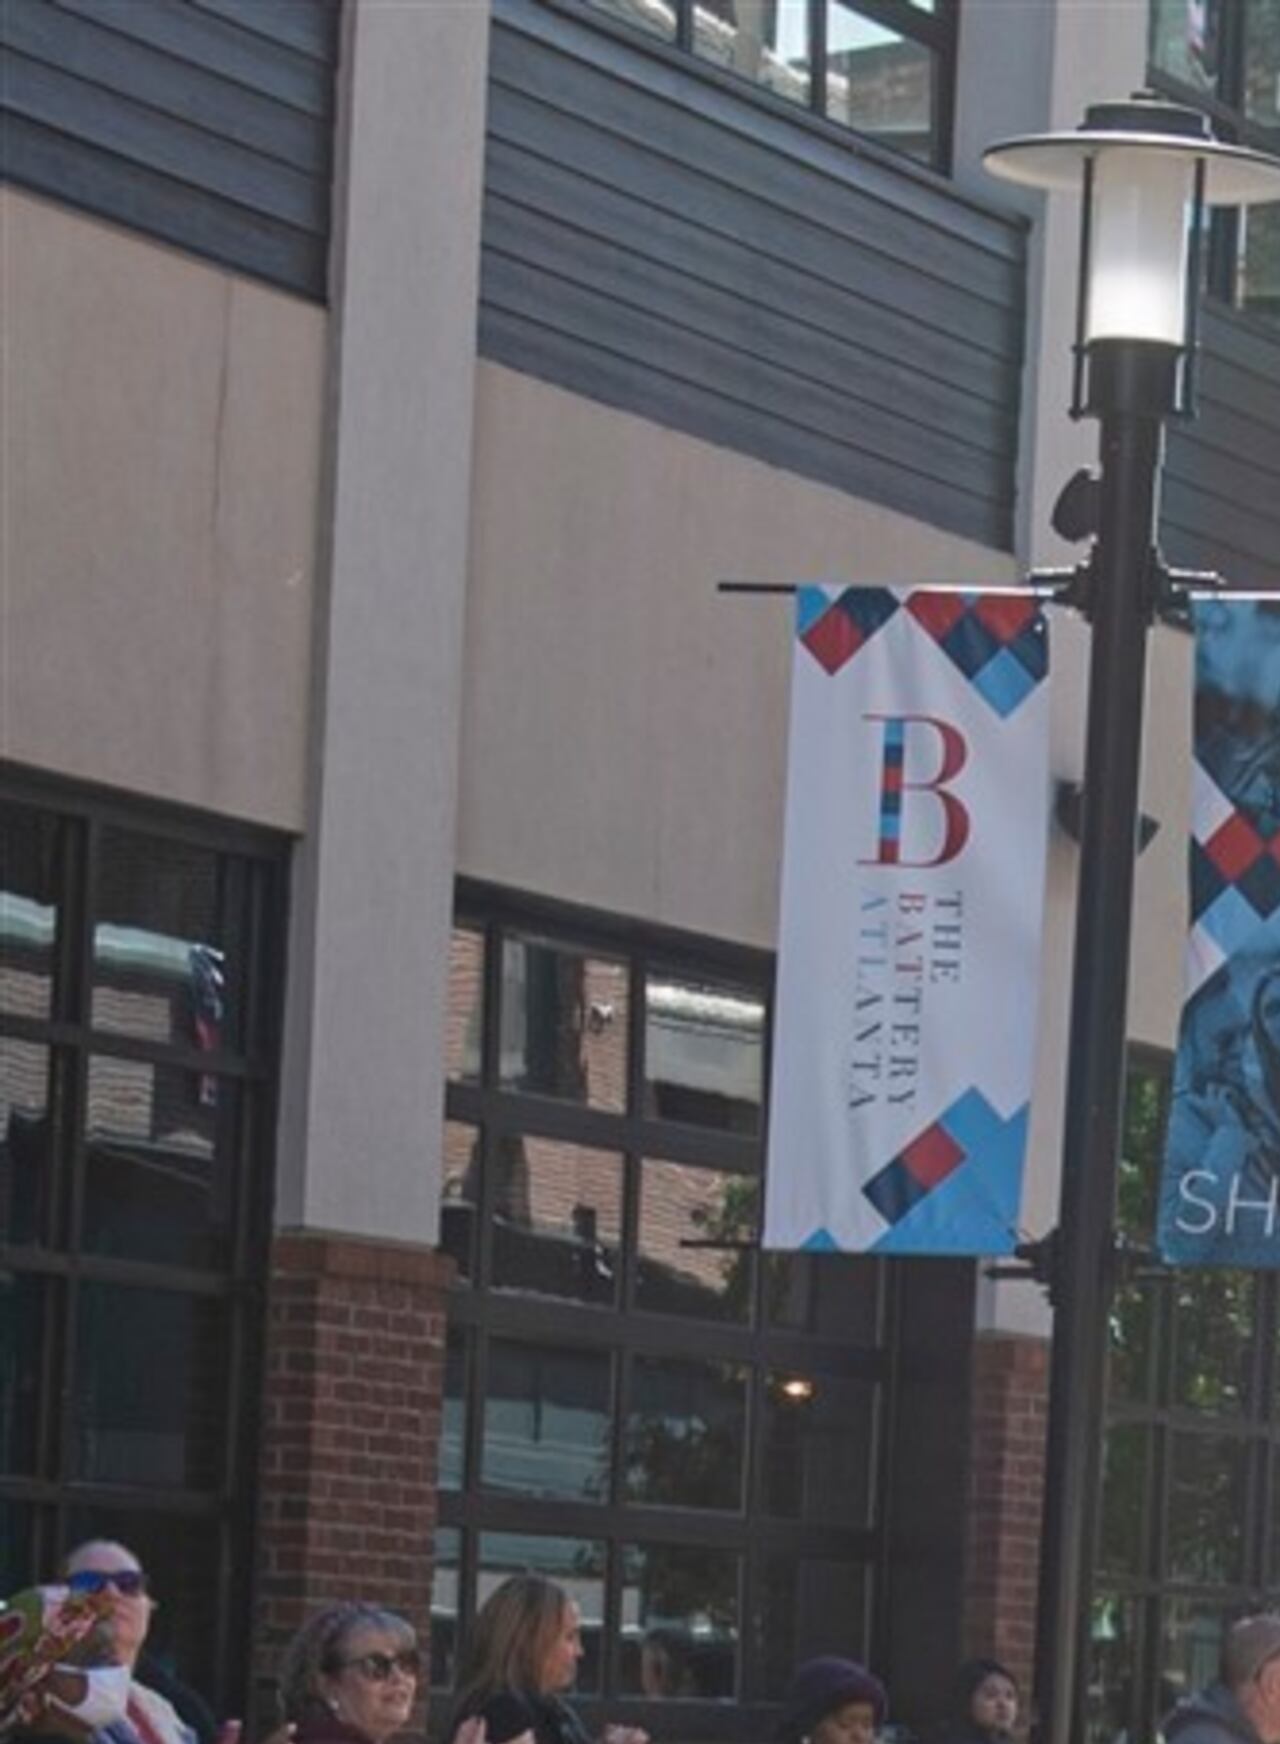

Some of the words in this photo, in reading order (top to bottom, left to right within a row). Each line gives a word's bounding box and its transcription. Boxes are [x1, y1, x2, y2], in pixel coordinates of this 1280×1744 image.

[856, 713, 971, 869] B
[848, 890, 888, 1111] ATLANTA
[887, 892, 926, 1110] BATTERY
[930, 890, 963, 983] THE
